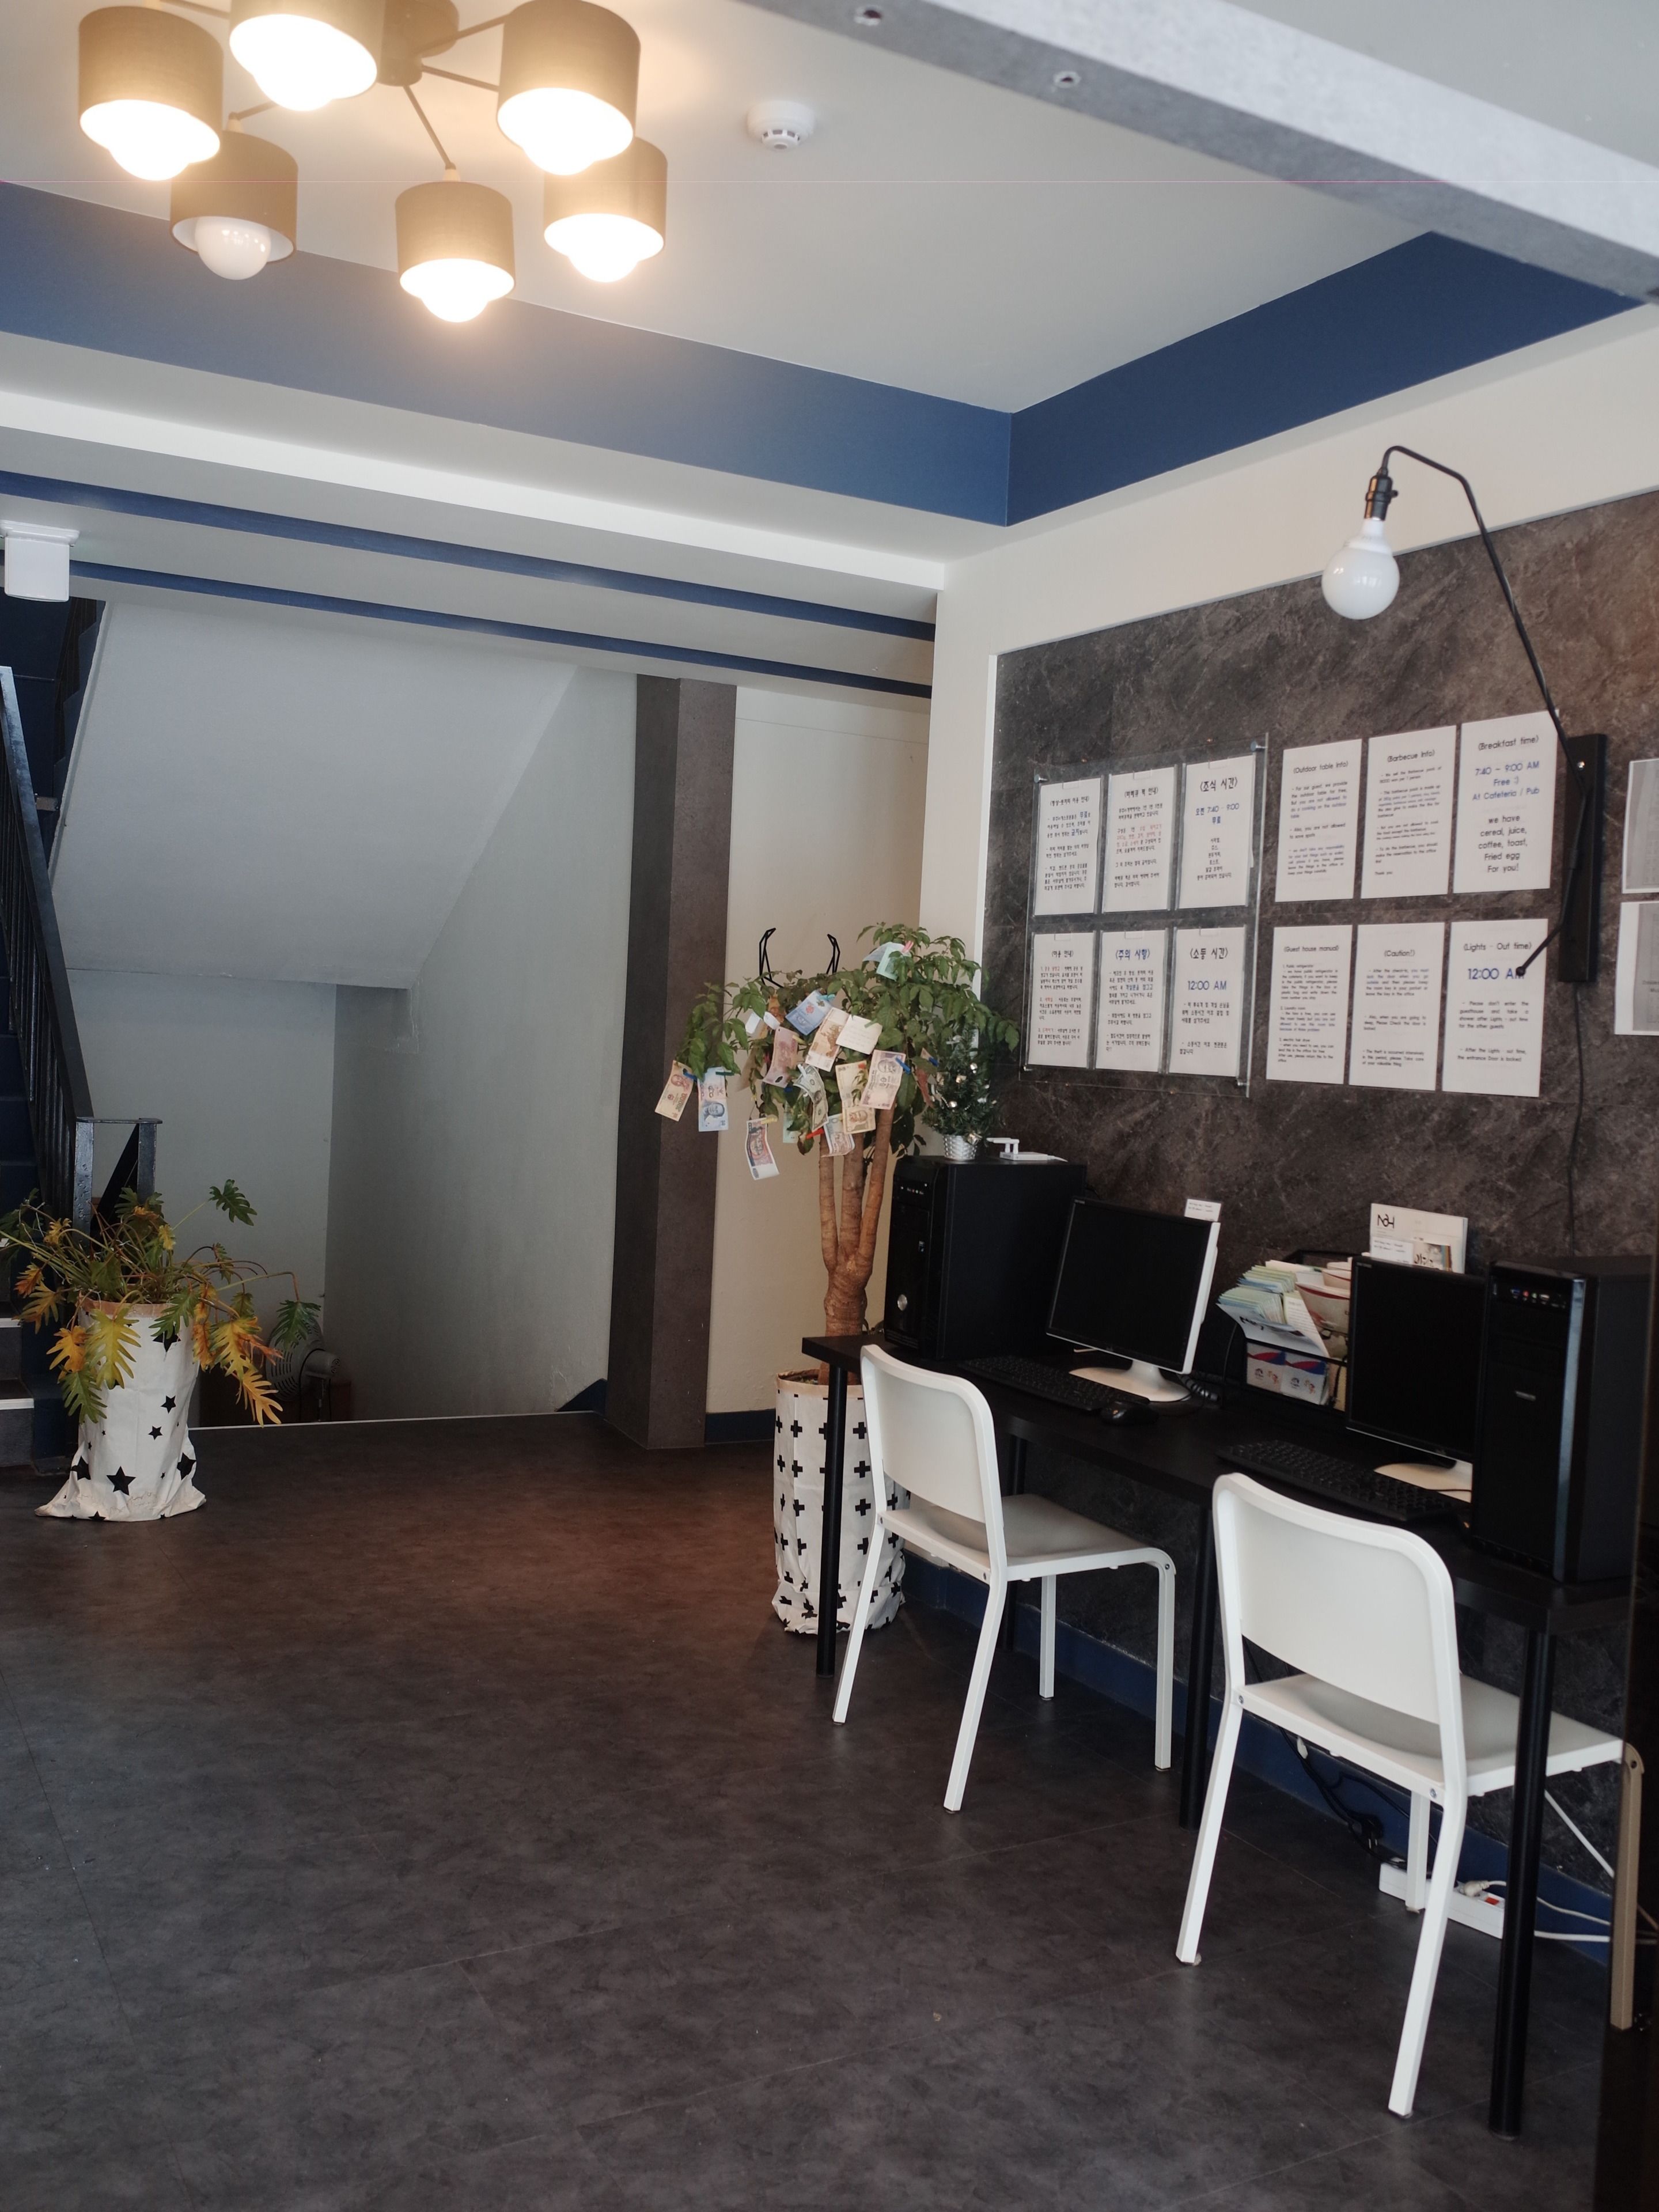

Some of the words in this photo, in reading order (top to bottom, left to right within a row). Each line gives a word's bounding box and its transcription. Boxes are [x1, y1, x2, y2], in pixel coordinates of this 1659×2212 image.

[1475, 767, 1491, 775] 7:40
[1505, 763, 1522, 771] 9:00
[1527, 760, 1539, 769] AM
[1483, 791, 1516, 799] Cafeteria
[1484, 852, 1502, 860] Fried
[1505, 853, 1520, 861] egg
[1502, 863, 1518, 873] you!
[1467, 968, 1499, 980] 12:00
[1187, 980, 1209, 990] 12:00
[1213, 980, 1226, 990] AM
